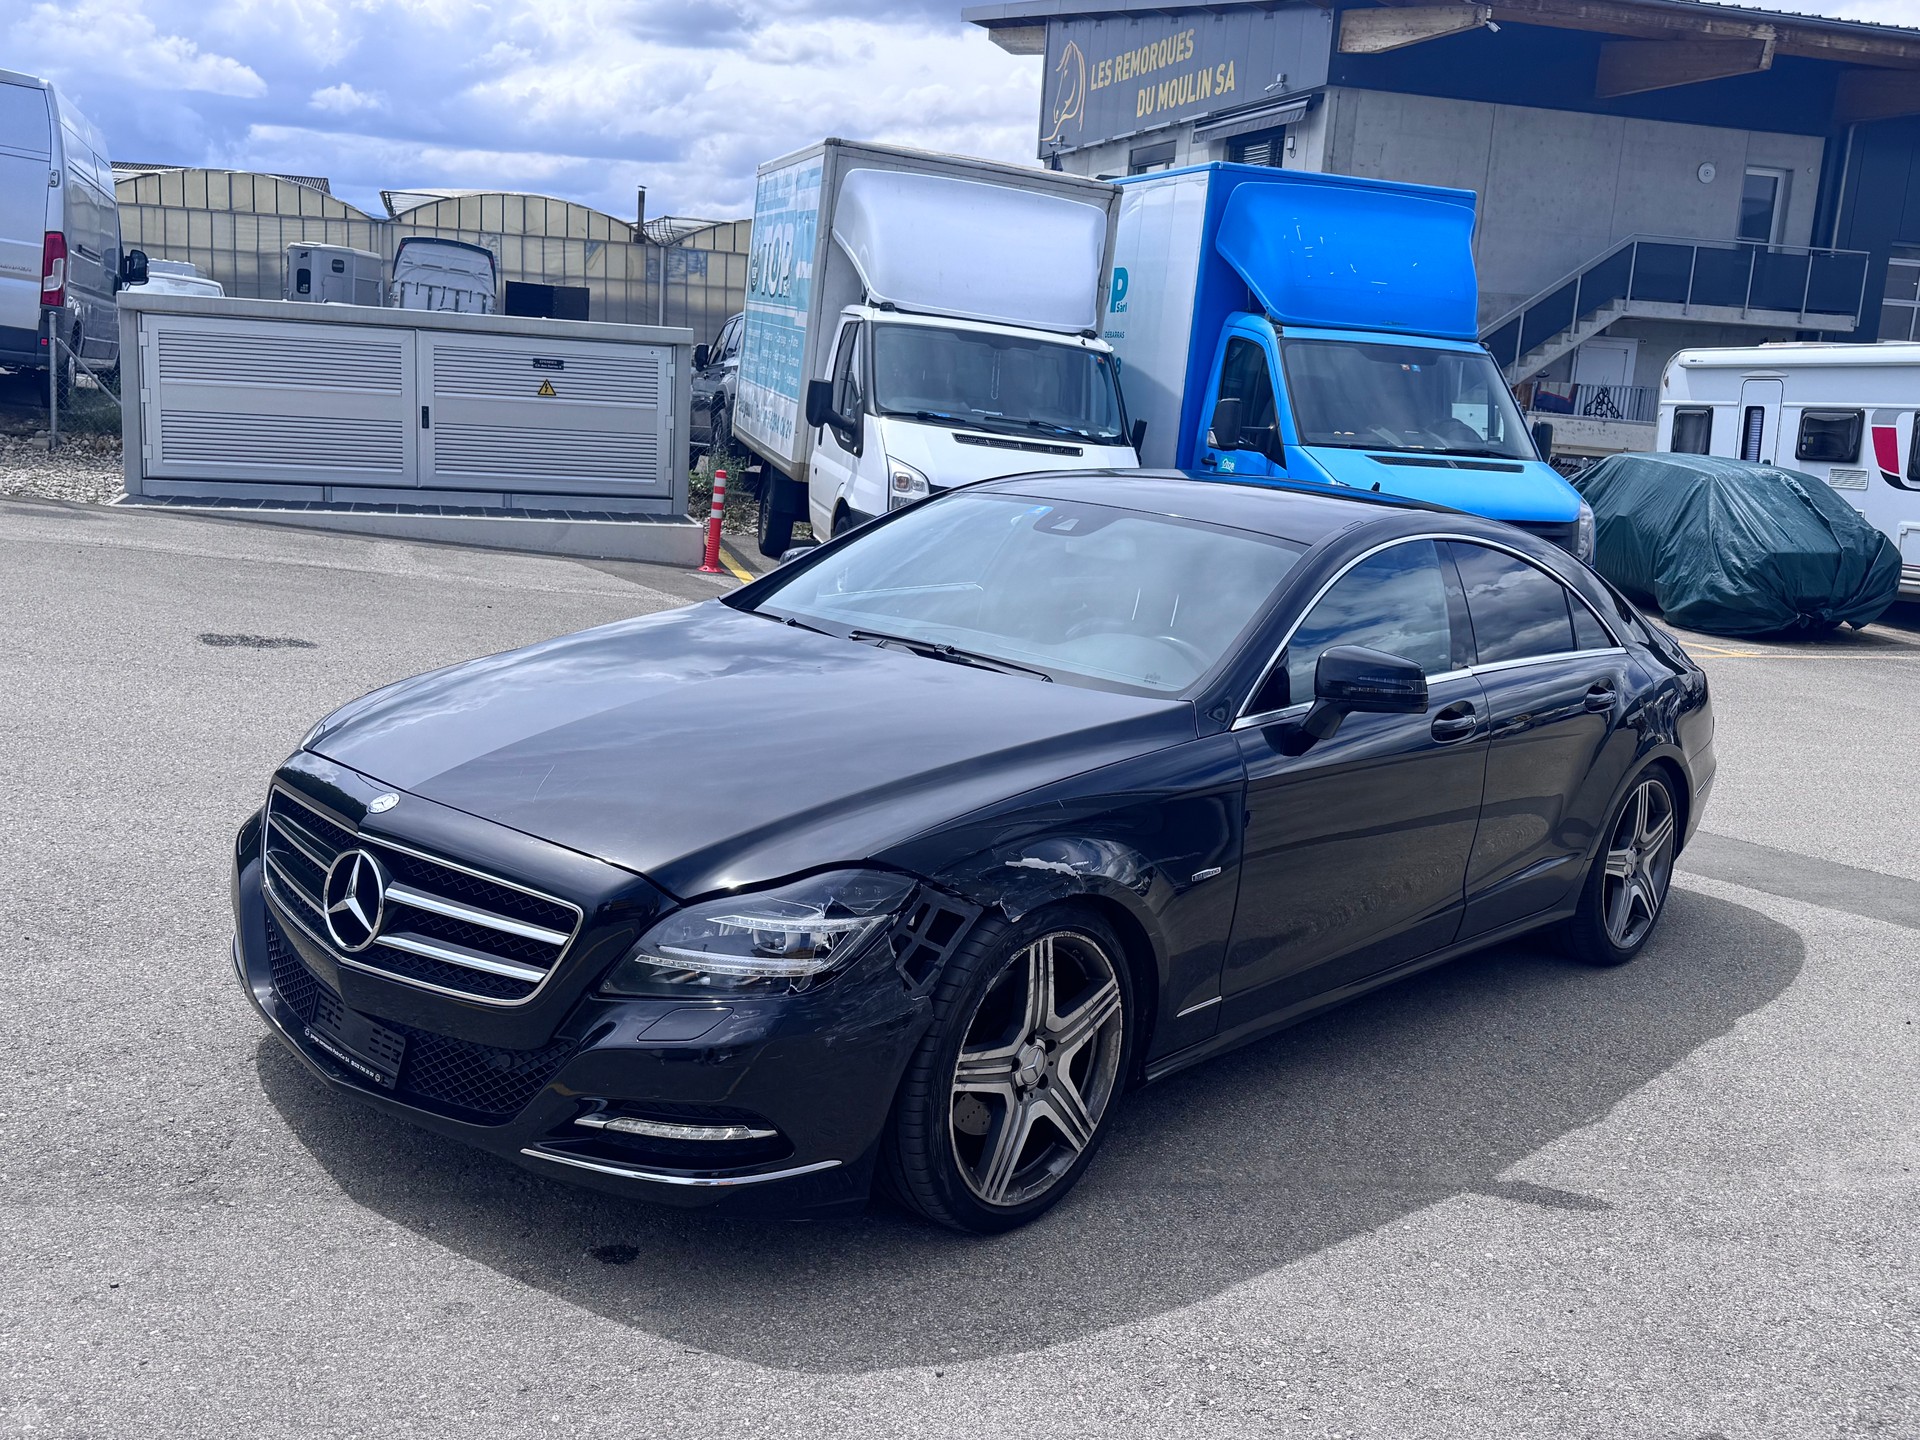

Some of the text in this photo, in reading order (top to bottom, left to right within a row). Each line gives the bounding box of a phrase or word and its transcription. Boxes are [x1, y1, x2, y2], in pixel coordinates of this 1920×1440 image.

[1091, 28, 1195, 91] LES REMORQUES
[1136, 60, 1235, 118] DU MOULIN SA
[761, 223, 794, 297] TOP
